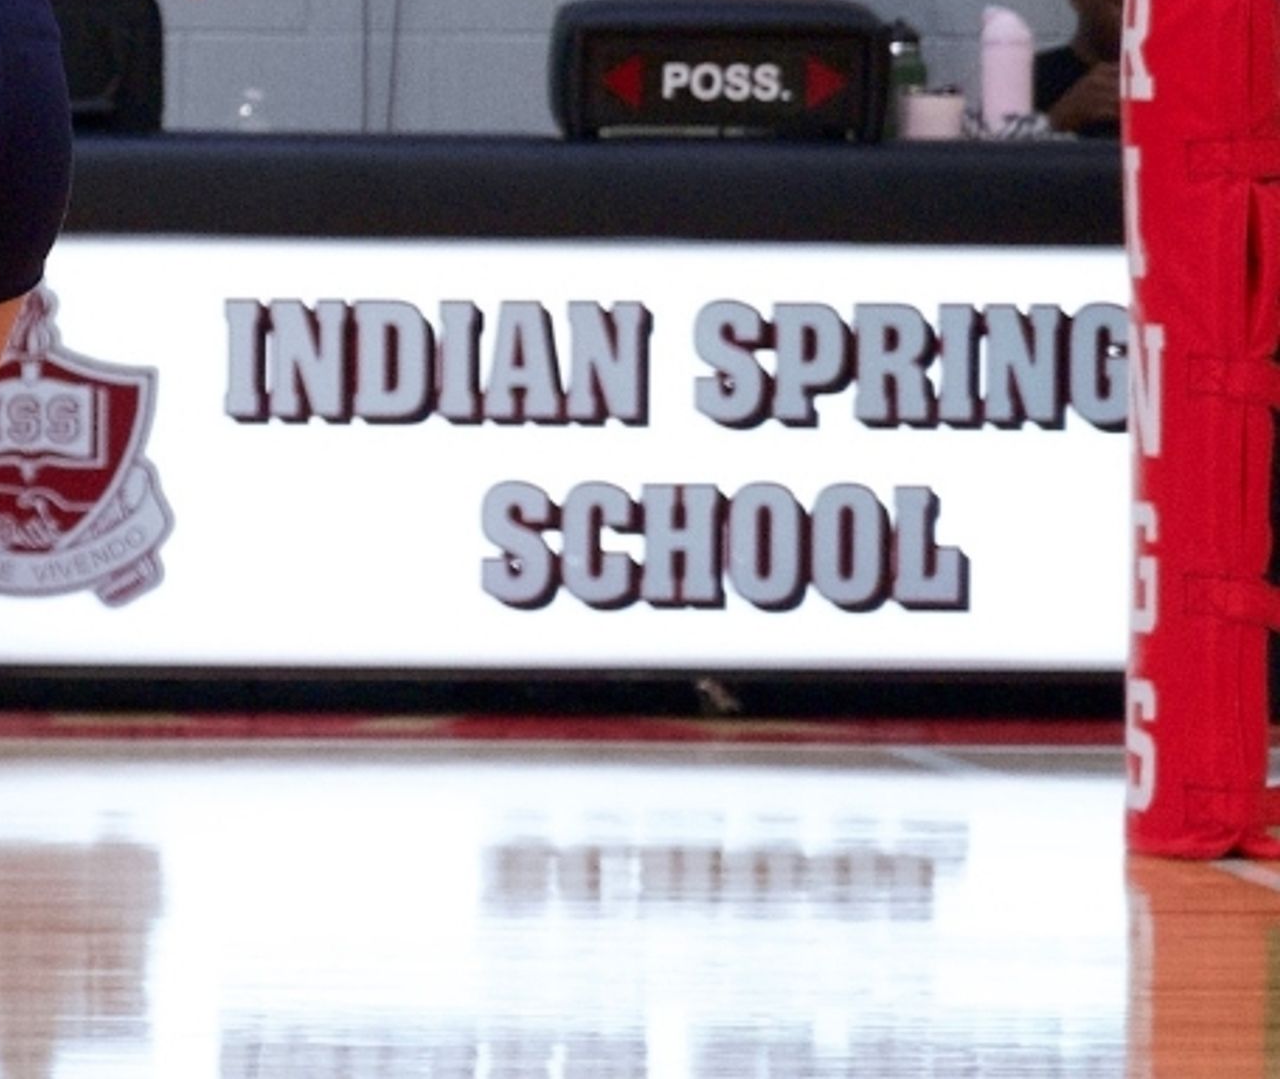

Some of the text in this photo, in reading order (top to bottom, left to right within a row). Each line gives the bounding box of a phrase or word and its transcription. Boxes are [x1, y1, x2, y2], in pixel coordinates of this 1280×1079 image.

[661, 61, 792, 102] POSS.
[224, 298, 653, 427] INDIAN
[481, 480, 970, 613] SCHOOL
